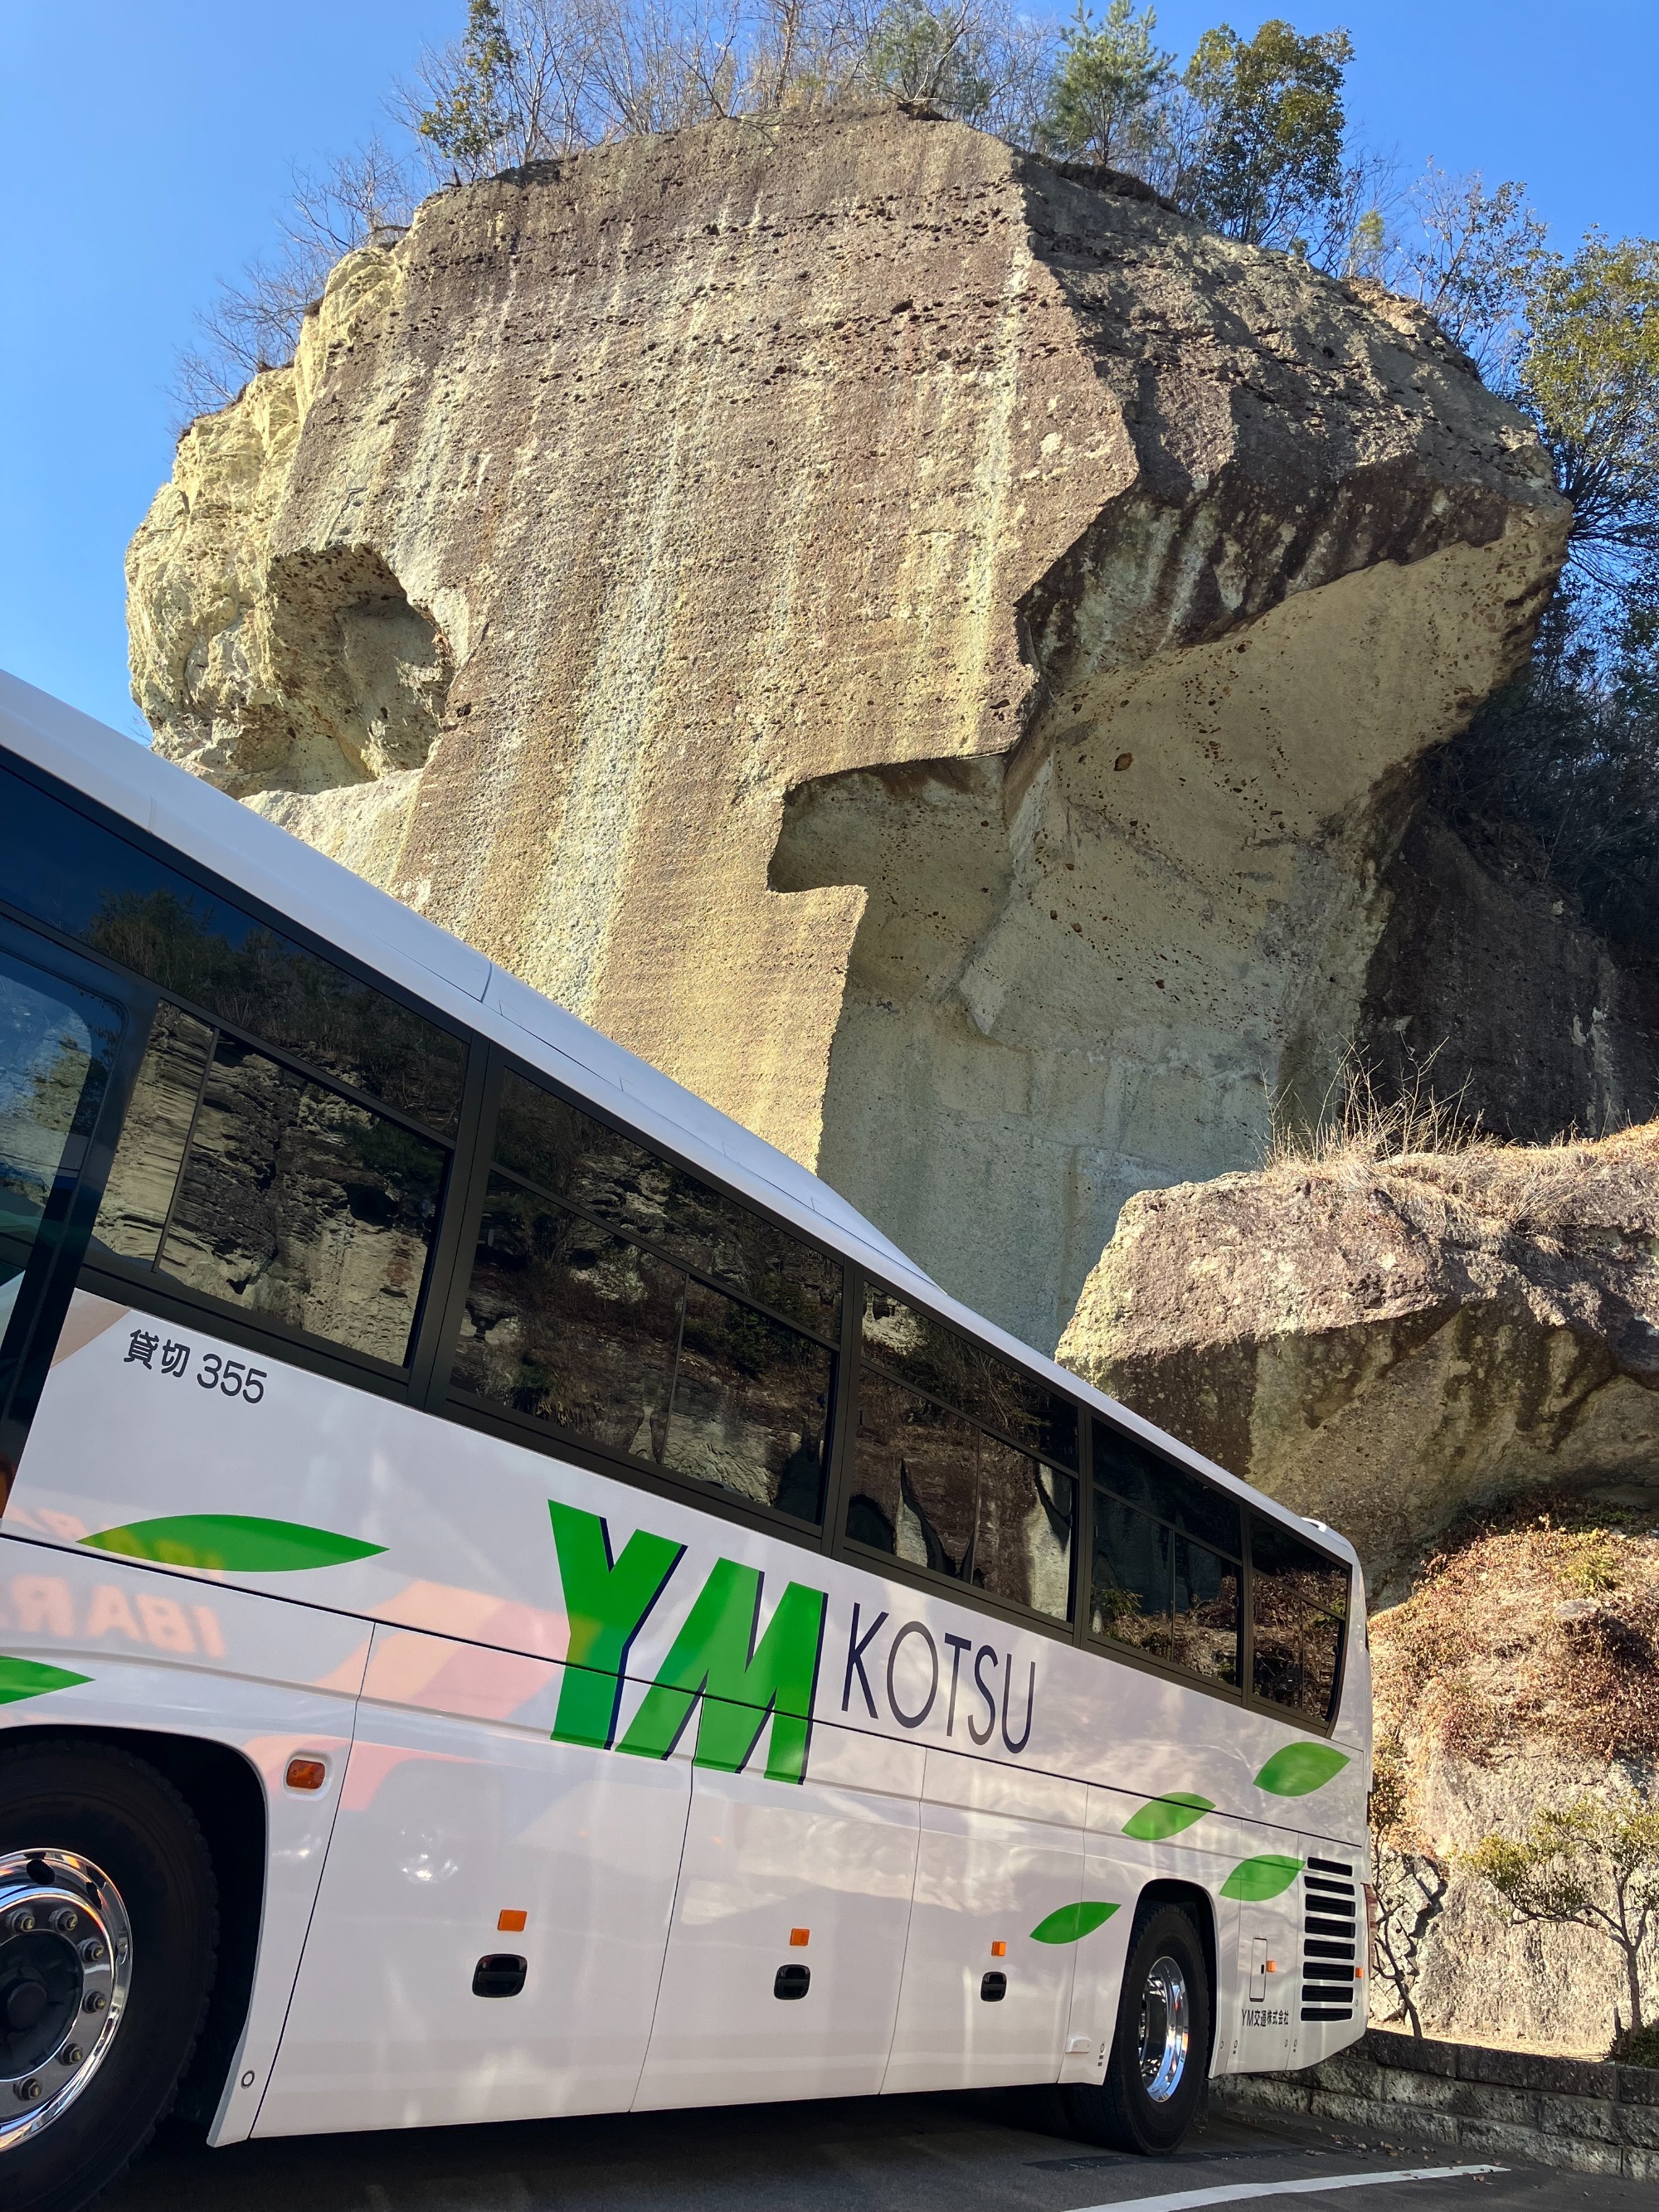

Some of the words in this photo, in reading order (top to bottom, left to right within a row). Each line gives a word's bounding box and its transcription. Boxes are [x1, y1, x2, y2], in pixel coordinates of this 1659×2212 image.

[124, 1329, 190, 1378] 貸切
[197, 1354, 267, 1403] 355
[547, 1499, 828, 1785] YM
[841, 1602, 1036, 1753] KOTSU
